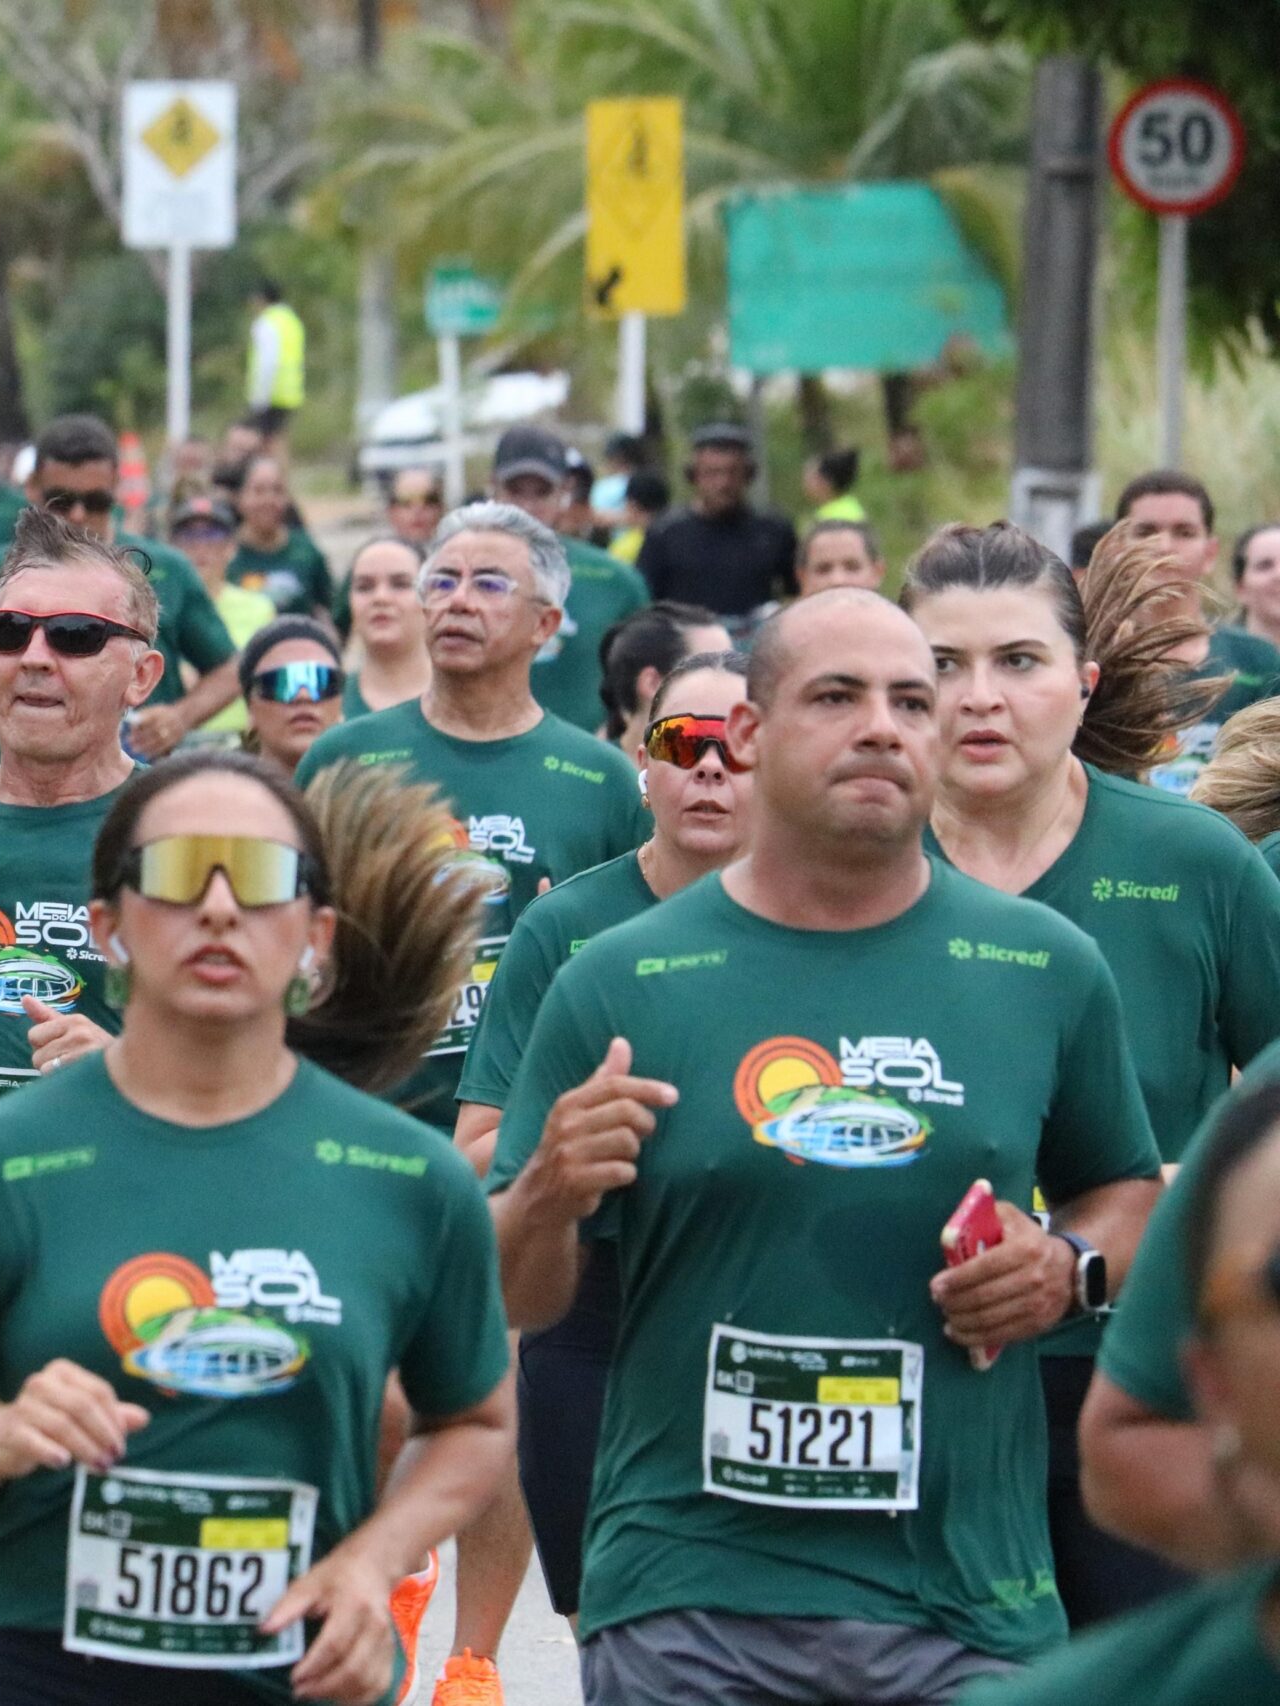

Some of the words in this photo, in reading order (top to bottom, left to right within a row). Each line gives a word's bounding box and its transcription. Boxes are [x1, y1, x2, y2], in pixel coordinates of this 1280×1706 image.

[1140, 112, 1213, 166] 50
[469, 830, 535, 854] SOL
[1116, 881, 1179, 901] Sicredi
[15, 902, 91, 922] MEIA
[977, 943, 1050, 969] Sicredi
[839, 1036, 939, 1060] MEIA
[840, 1058, 964, 1092] SOL
[212, 1273, 342, 1308] SOL
[748, 1403, 874, 1467] 51221
[118, 1548, 264, 1617] 51862
